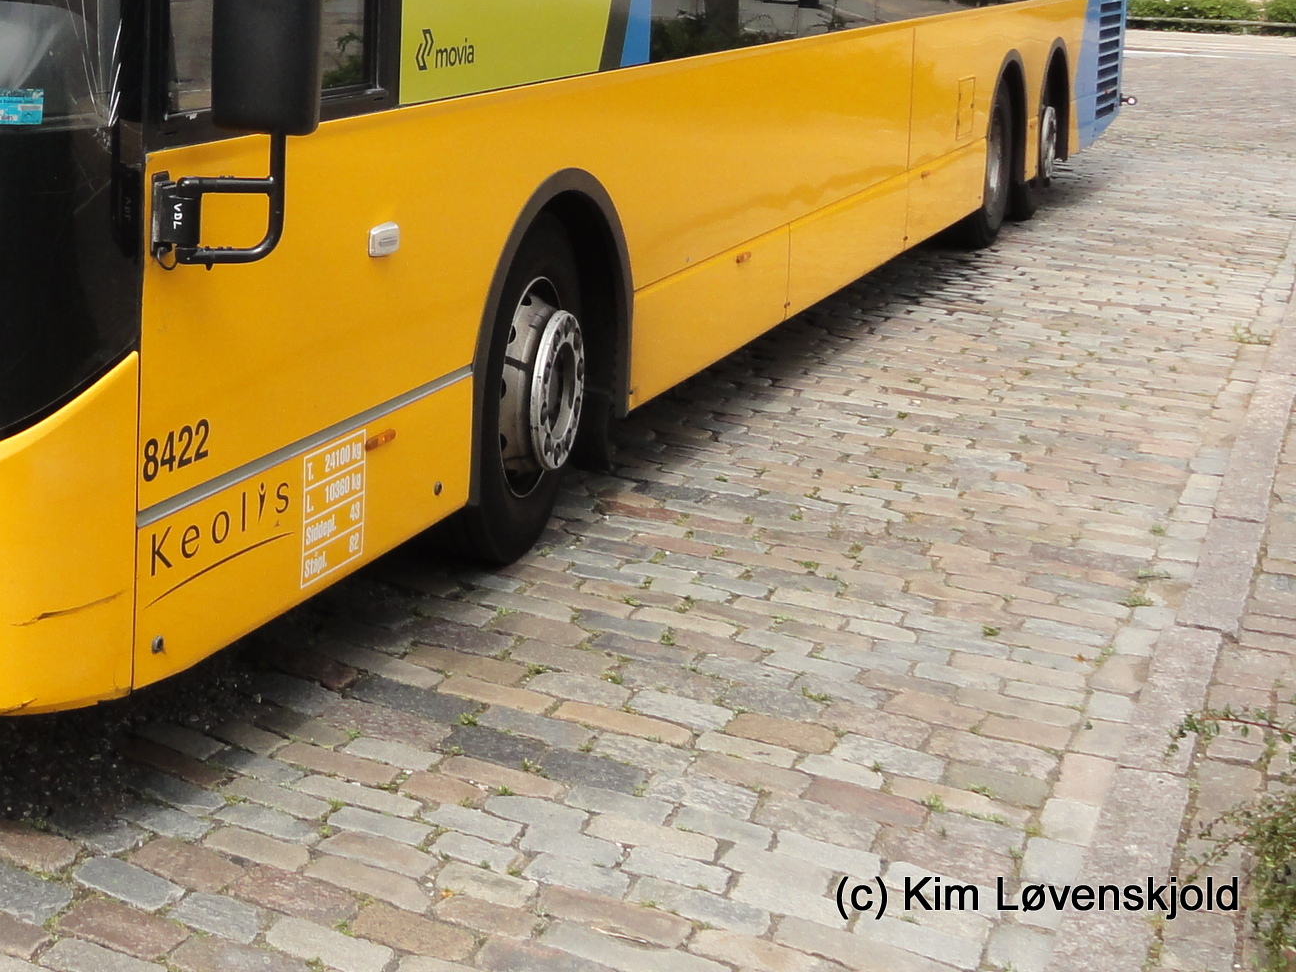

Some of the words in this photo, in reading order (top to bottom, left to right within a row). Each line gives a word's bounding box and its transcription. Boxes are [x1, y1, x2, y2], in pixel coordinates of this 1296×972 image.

[434, 37, 475, 69] movia
[172, 202, 183, 230] VDL
[142, 418, 210, 483] 8422
[352, 442, 362, 460] kg
[306, 495, 314, 513] L.
[351, 473, 361, 491] kg
[349, 501, 361, 521] 43
[150, 482, 290, 577] Keolis
